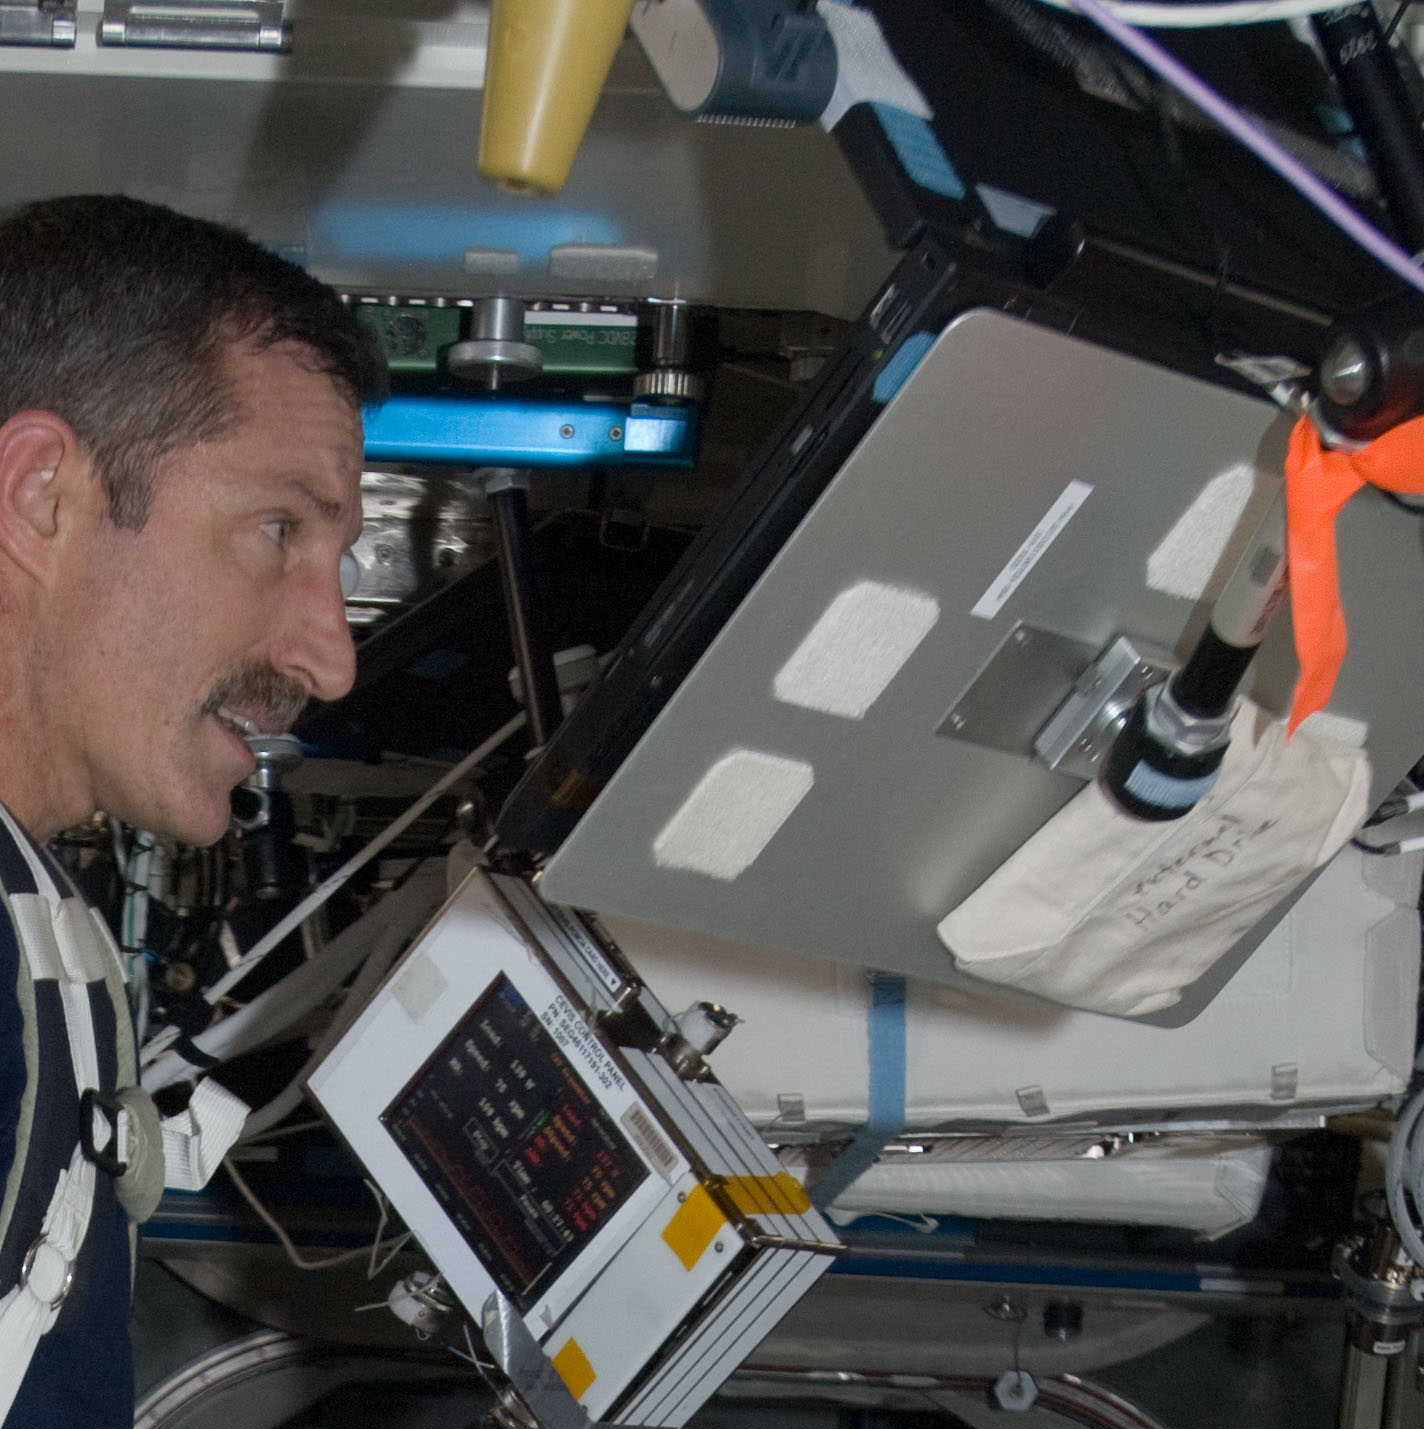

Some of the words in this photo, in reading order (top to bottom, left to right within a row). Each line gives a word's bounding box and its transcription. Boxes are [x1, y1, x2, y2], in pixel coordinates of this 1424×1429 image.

[555, 994, 576, 1024] CEVIS
[574, 1020, 605, 1064] CONTROL
[604, 1062, 626, 1092] PANEL
